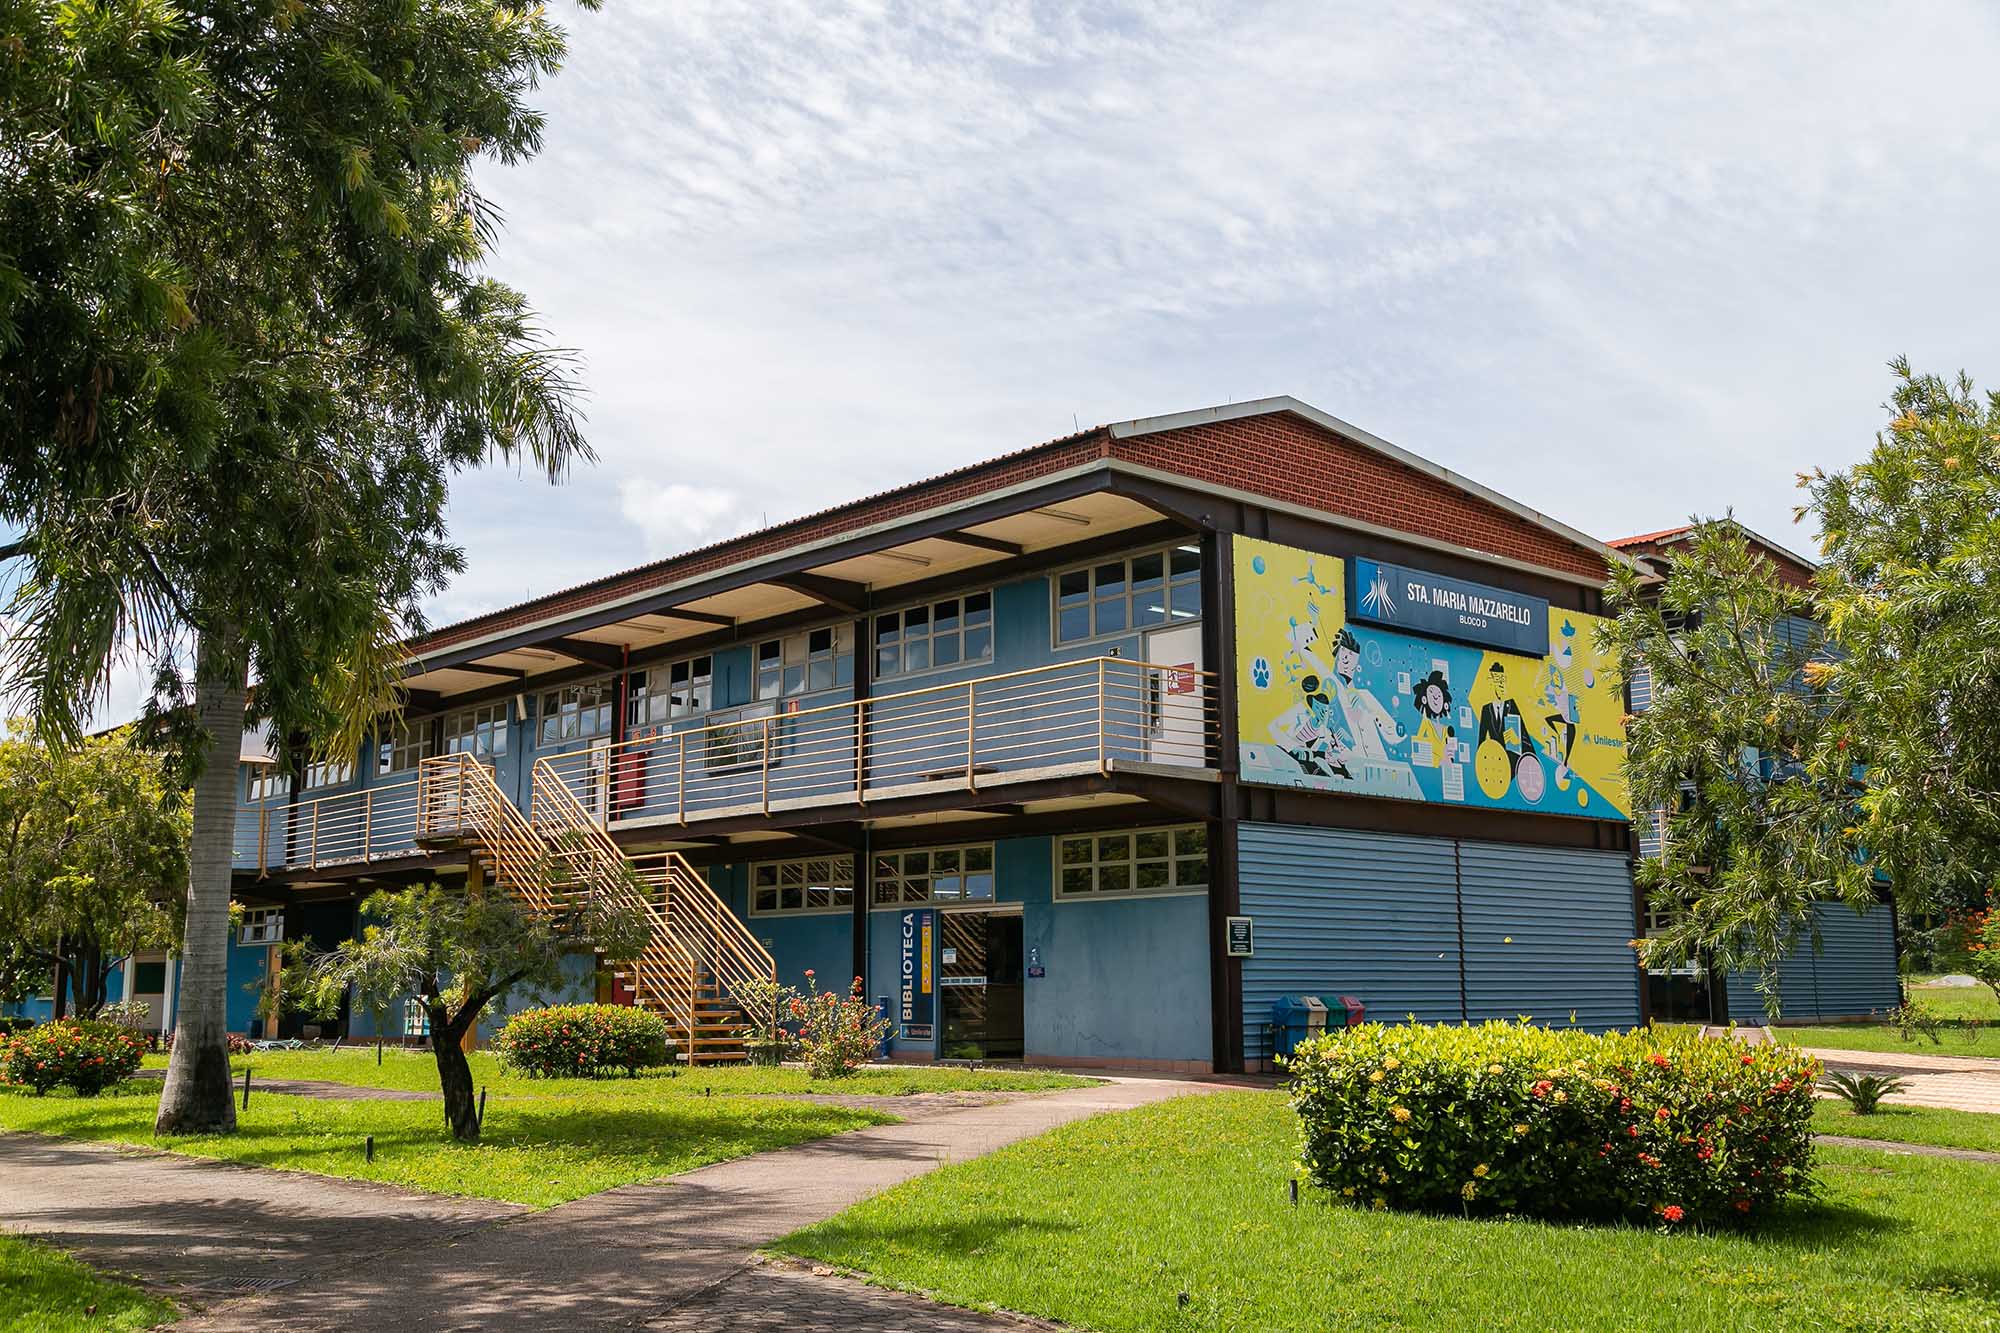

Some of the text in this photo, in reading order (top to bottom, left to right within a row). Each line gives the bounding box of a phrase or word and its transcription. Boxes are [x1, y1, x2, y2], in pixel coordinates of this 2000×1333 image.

[1407, 582, 1531, 625] STA. MARIA MAZZARELLO
[1459, 614, 1487, 629] BLOCO D
[903, 913, 914, 1020] BIBLIOTECA
